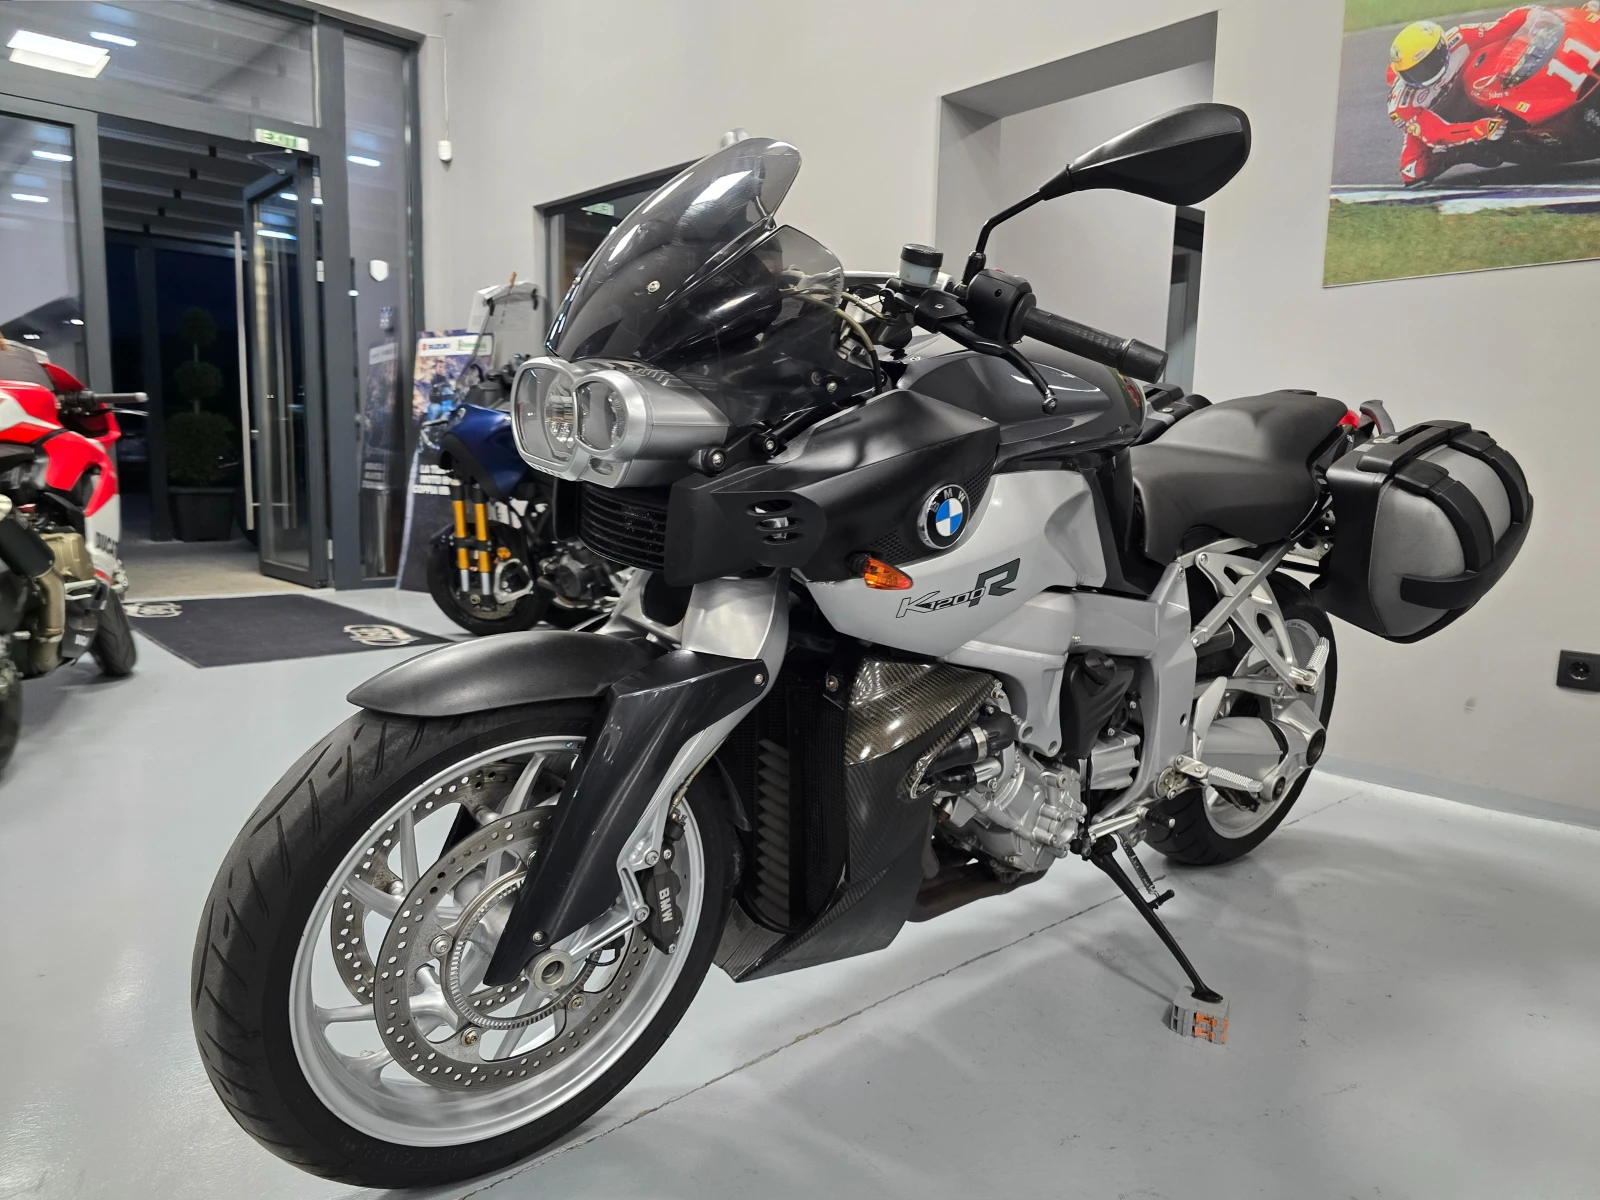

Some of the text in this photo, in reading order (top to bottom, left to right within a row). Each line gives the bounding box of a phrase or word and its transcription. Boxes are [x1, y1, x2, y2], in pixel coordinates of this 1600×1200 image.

[1546, 38, 1600, 93] 11
[930, 488, 966, 513] BMW
[659, 887, 673, 922] BMW
